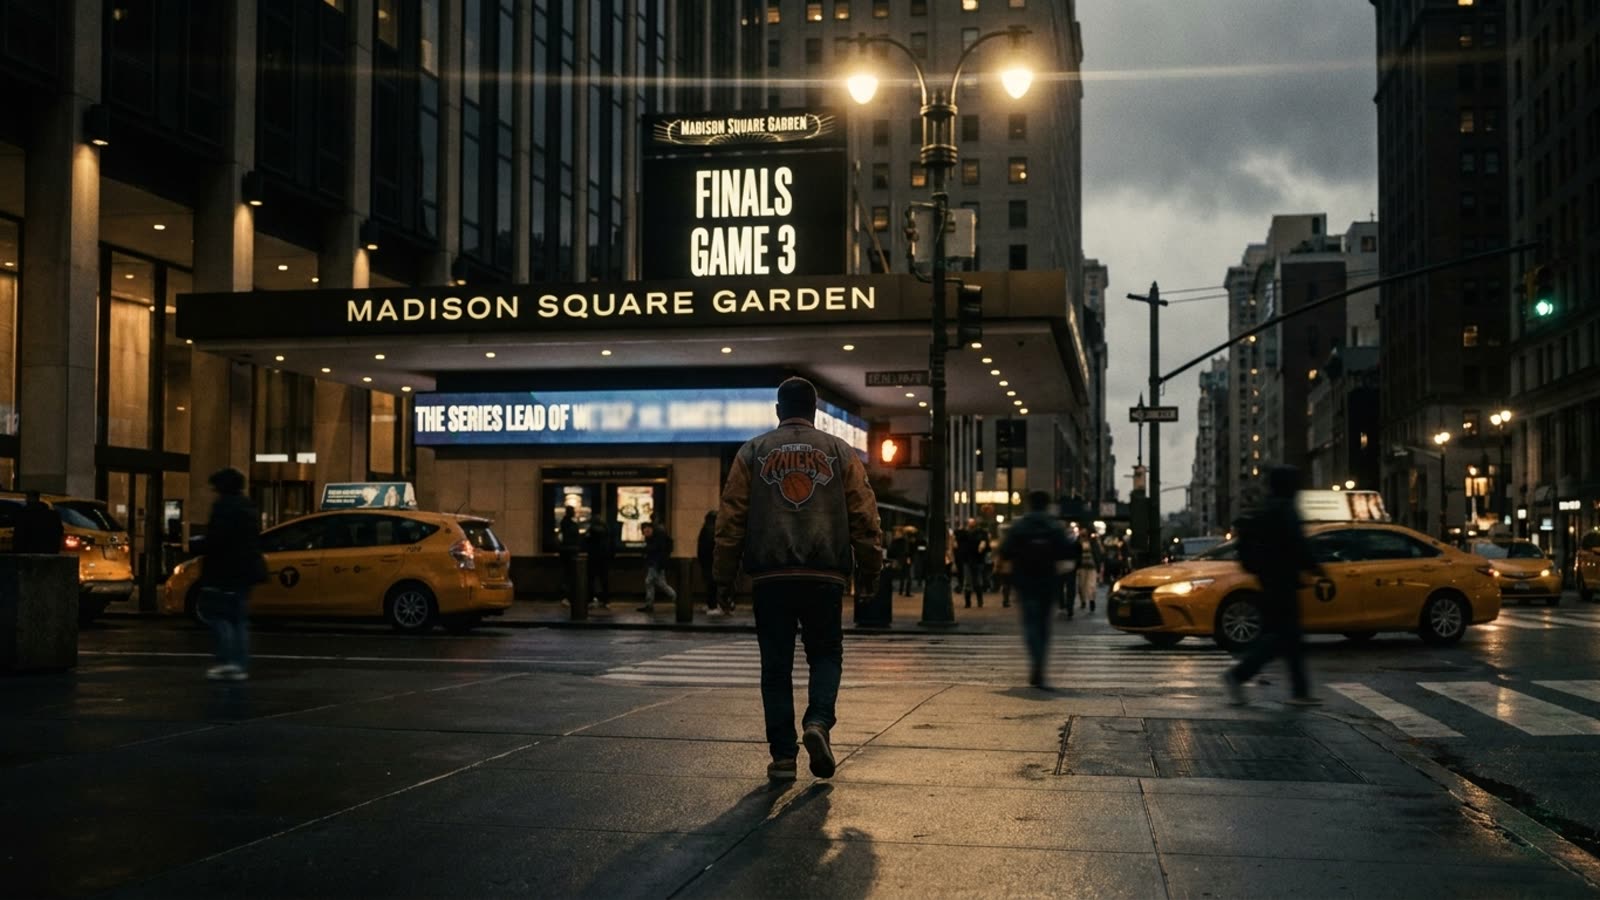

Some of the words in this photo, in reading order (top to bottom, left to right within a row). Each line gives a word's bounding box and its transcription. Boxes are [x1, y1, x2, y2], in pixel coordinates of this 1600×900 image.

[728, 116, 766, 136] SQUARE
[696, 167, 793, 219] FINALS
[691, 226, 770, 278] GAME
[777, 224, 797, 275] 3
[347, 296, 518, 322] MADISON
[537, 292, 694, 319] SQUARE
[712, 286, 875, 314] GARDEN
[415, 405, 446, 432] THE
[447, 404, 504, 433] SERIES
[505, 403, 546, 432] LEAD
[548, 403, 570, 432] OF
